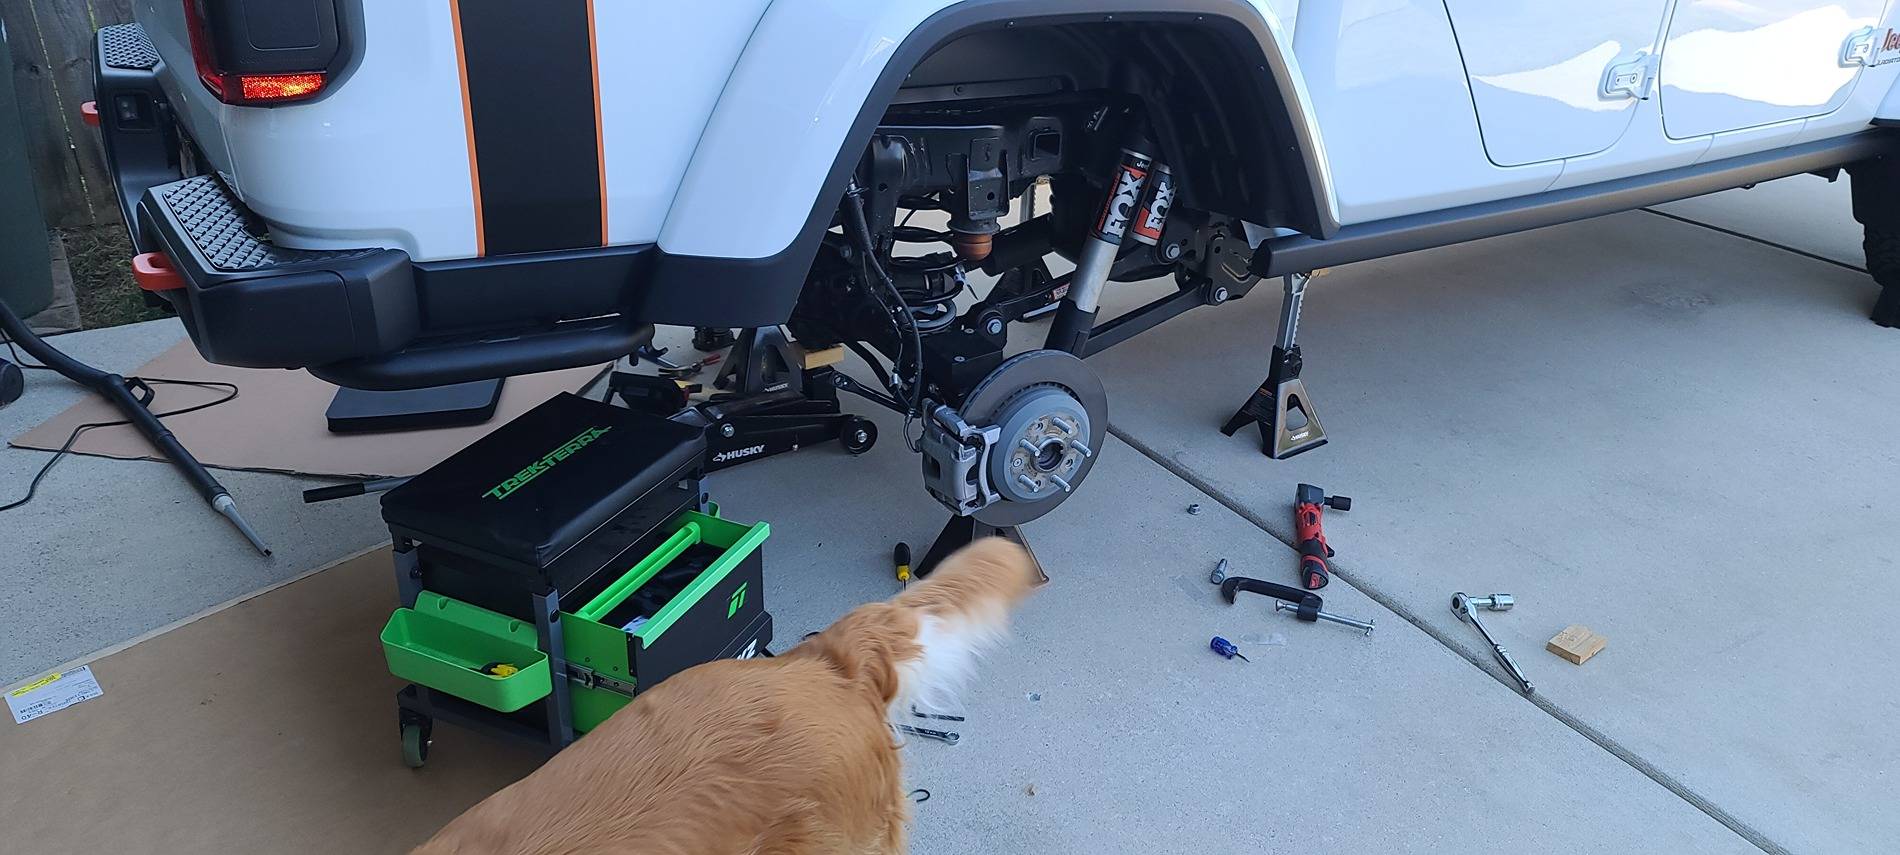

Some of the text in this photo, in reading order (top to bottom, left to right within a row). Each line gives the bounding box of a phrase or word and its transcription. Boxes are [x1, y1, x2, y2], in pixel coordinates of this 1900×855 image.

[1102, 170, 1146, 238] FOX
[1145, 181, 1175, 232] FOX
[726, 445, 765, 460] HUSKY
